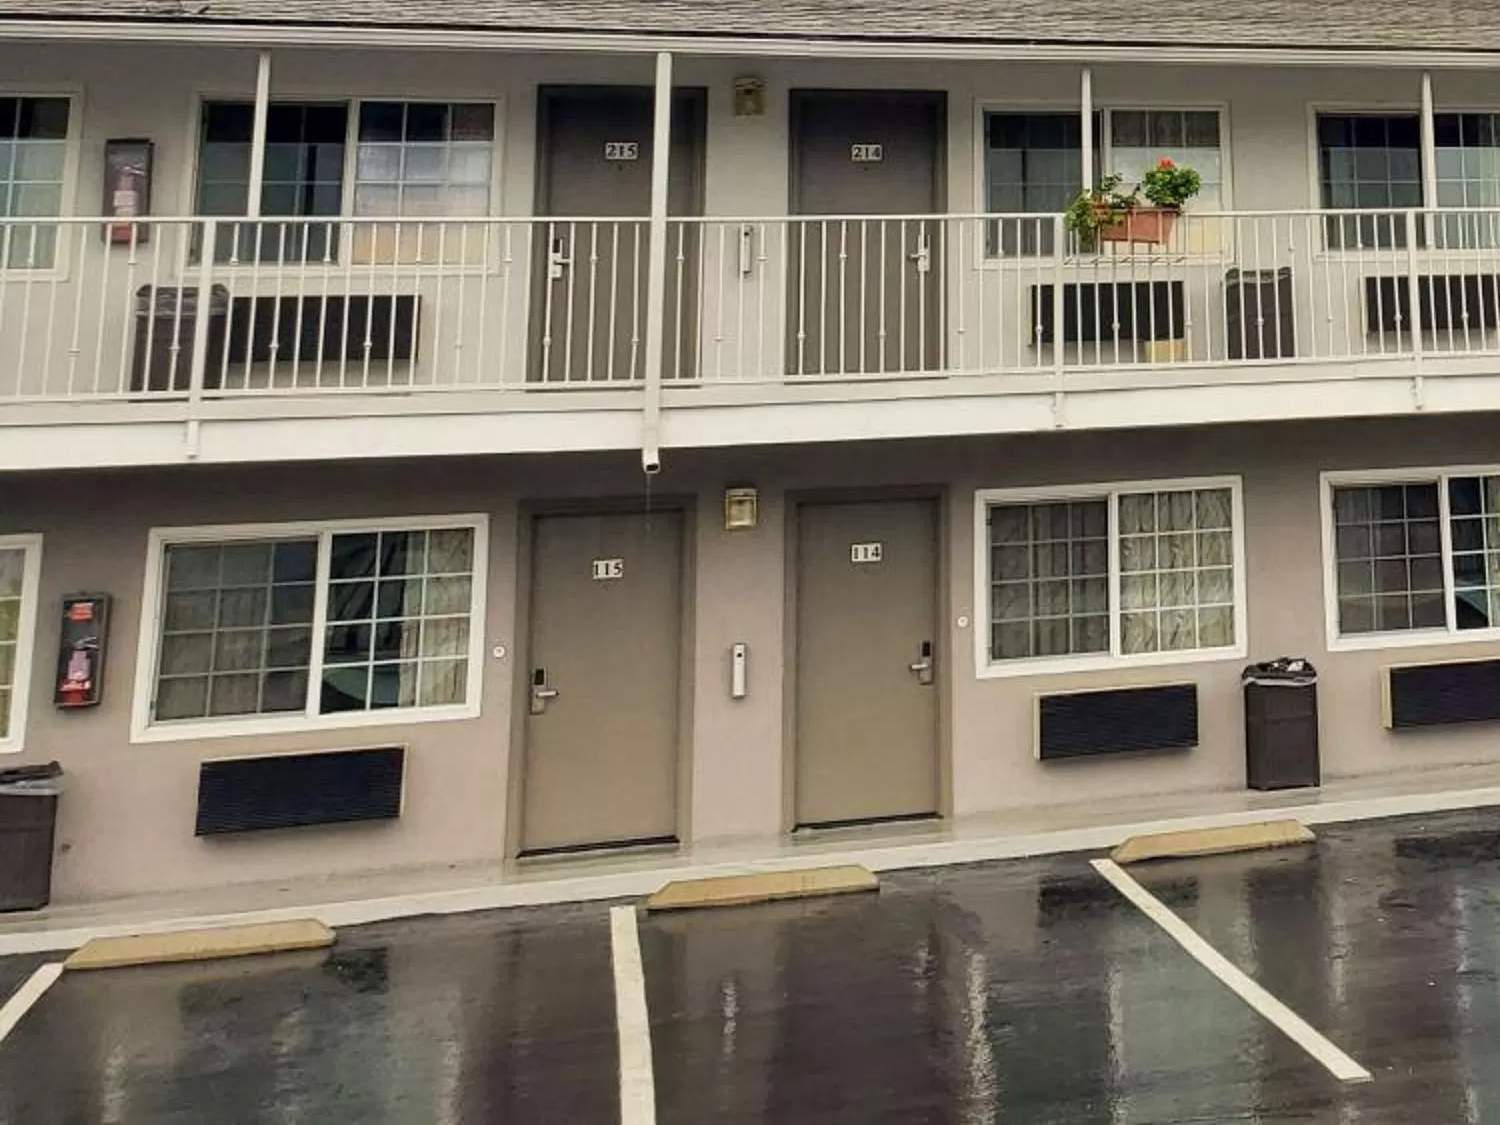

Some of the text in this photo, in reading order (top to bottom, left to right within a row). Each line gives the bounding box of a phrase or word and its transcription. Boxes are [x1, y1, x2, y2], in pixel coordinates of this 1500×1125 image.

[606, 143, 637, 159] 215
[853, 145, 882, 160] 214
[853, 545, 880, 560] 114
[594, 561, 622, 577] 115
